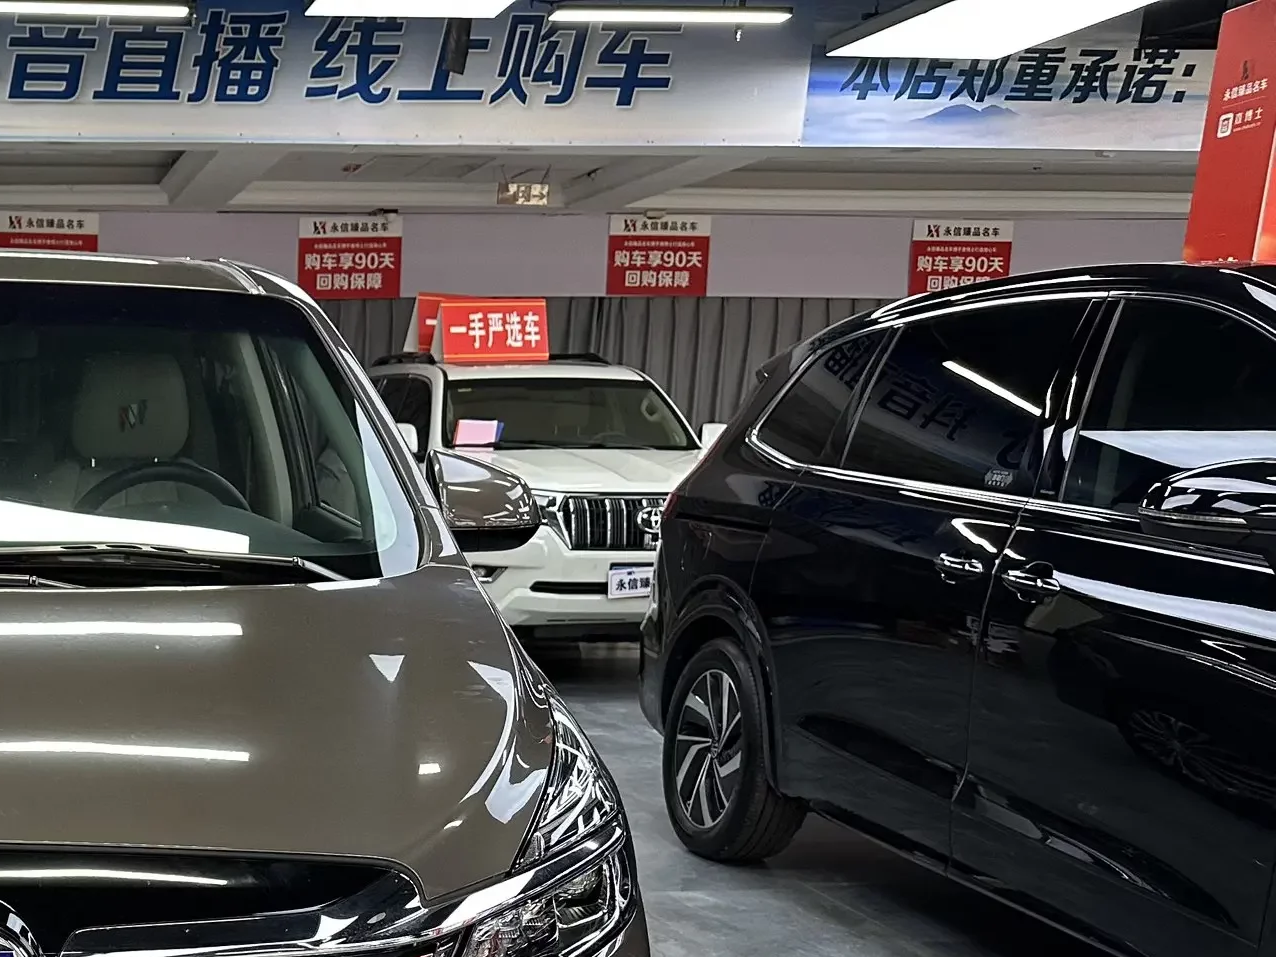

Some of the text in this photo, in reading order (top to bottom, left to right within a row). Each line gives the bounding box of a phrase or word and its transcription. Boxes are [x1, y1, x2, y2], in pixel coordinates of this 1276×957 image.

[304, 13, 684, 107] 线上购车
[25, 217, 85, 230] 永信臻品名车
[330, 221, 389, 233] 永信臻品名车
[640, 220, 698, 232] 永信臻品名车
[943, 226, 1001, 238] 永信臻品名车
[304, 252, 395, 270] 购车享90天
[614, 250, 703, 268] 购车享90天
[916, 256, 1005, 273] 购车享90天
[316, 272, 383, 290] 回购保障
[624, 270, 690, 288] 回购保障
[926, 275, 991, 292] 回购保
[449, 311, 542, 350] 一手严选车
